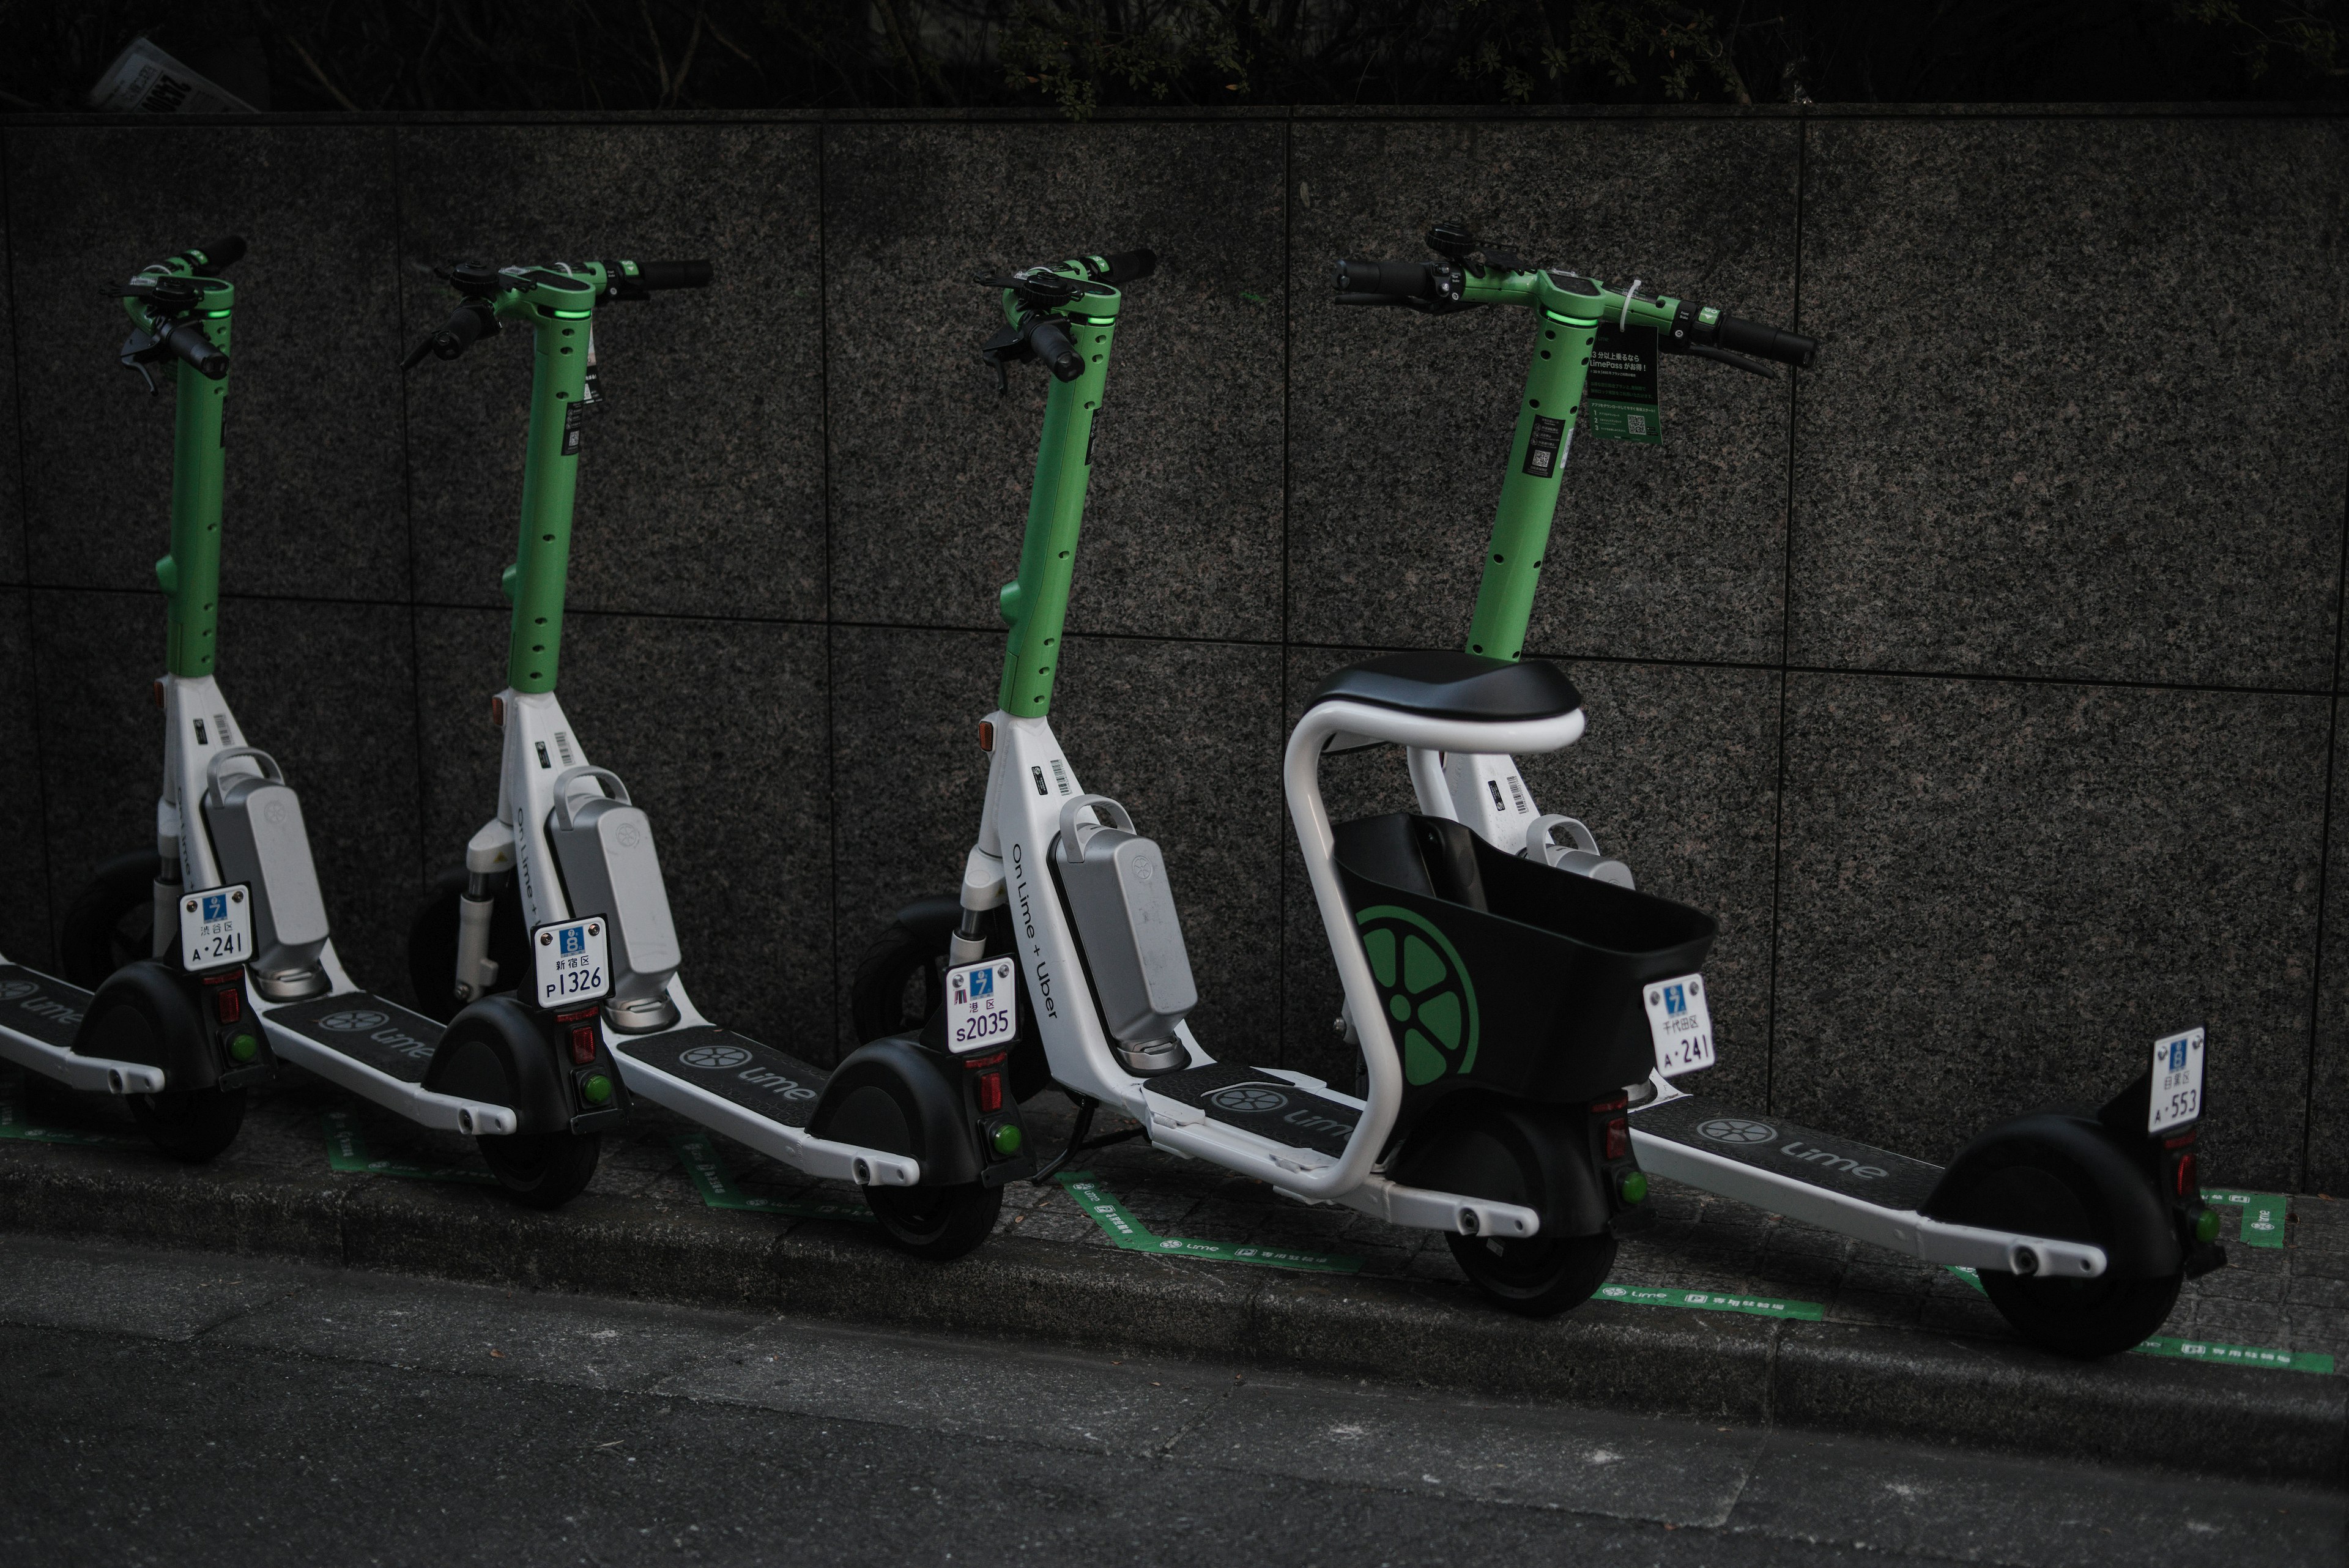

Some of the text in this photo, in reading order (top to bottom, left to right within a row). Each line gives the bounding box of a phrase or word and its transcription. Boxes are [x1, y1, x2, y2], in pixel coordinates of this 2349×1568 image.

[1590, 359, 1623, 370] LimePass
[518, 808, 524, 842] On
[521, 844, 533, 899] Lime
[201, 921, 234, 937] 渋谷区
[1012, 843, 1058, 1019] On Lime + Uber
[566, 937, 579, 952] 8
[555, 955, 590, 971] 新宿区
[1663, 1014, 1699, 1035] 千代田区
[371, 1027, 437, 1059] Lime
[738, 1066, 817, 1100] Lime
[1284, 1109, 1354, 1142] Lim
[1780, 1142, 1890, 1180] Lime
[1186, 1243, 1220, 1252] Lime
[1631, 1290, 1668, 1299] Lime
